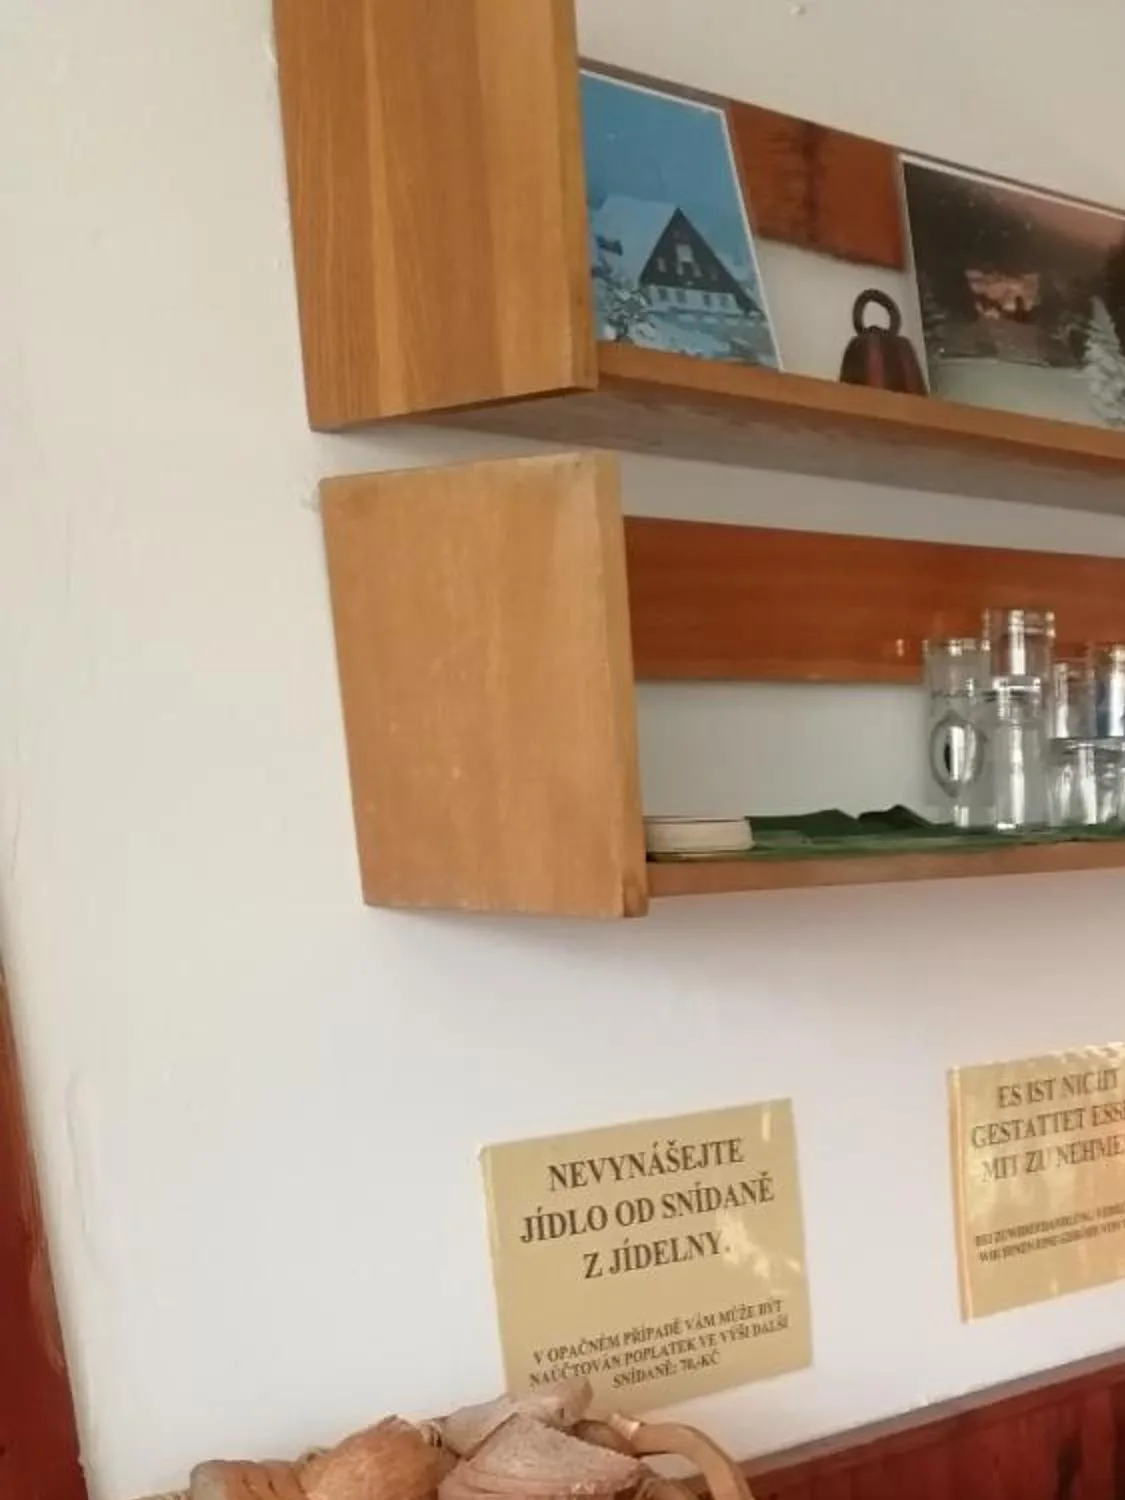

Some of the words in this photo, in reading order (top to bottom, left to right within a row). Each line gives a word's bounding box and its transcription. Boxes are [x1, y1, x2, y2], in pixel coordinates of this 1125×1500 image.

[998, 1085, 1022, 1108] ES
[1027, 1077, 1056, 1103] IST
[1062, 1068, 1119, 1097] NICHT
[971, 1107, 1086, 1149] GESTATTET
[548, 1137, 745, 1192] NEVYNÁŠEJTE
[982, 1152, 1019, 1181] MIT
[1025, 1148, 1052, 1173] ZU
[520, 1206, 608, 1243] JÍDLO
[615, 1197, 655, 1227] OD
[662, 1171, 775, 1220] SNÍDANĚ
[583, 1252, 603, 1280] Z
[609, 1229, 732, 1276] JÍDELNY.
[533, 1349, 544, 1365] V
[547, 1337, 621, 1363] OPAČNÉM
[623, 1317, 681, 1346] PŘÍPADĚ
[684, 1312, 715, 1331] VÁM
[625, 1338, 697, 1366] POPLATEK
[699, 1332, 717, 1348] VE
